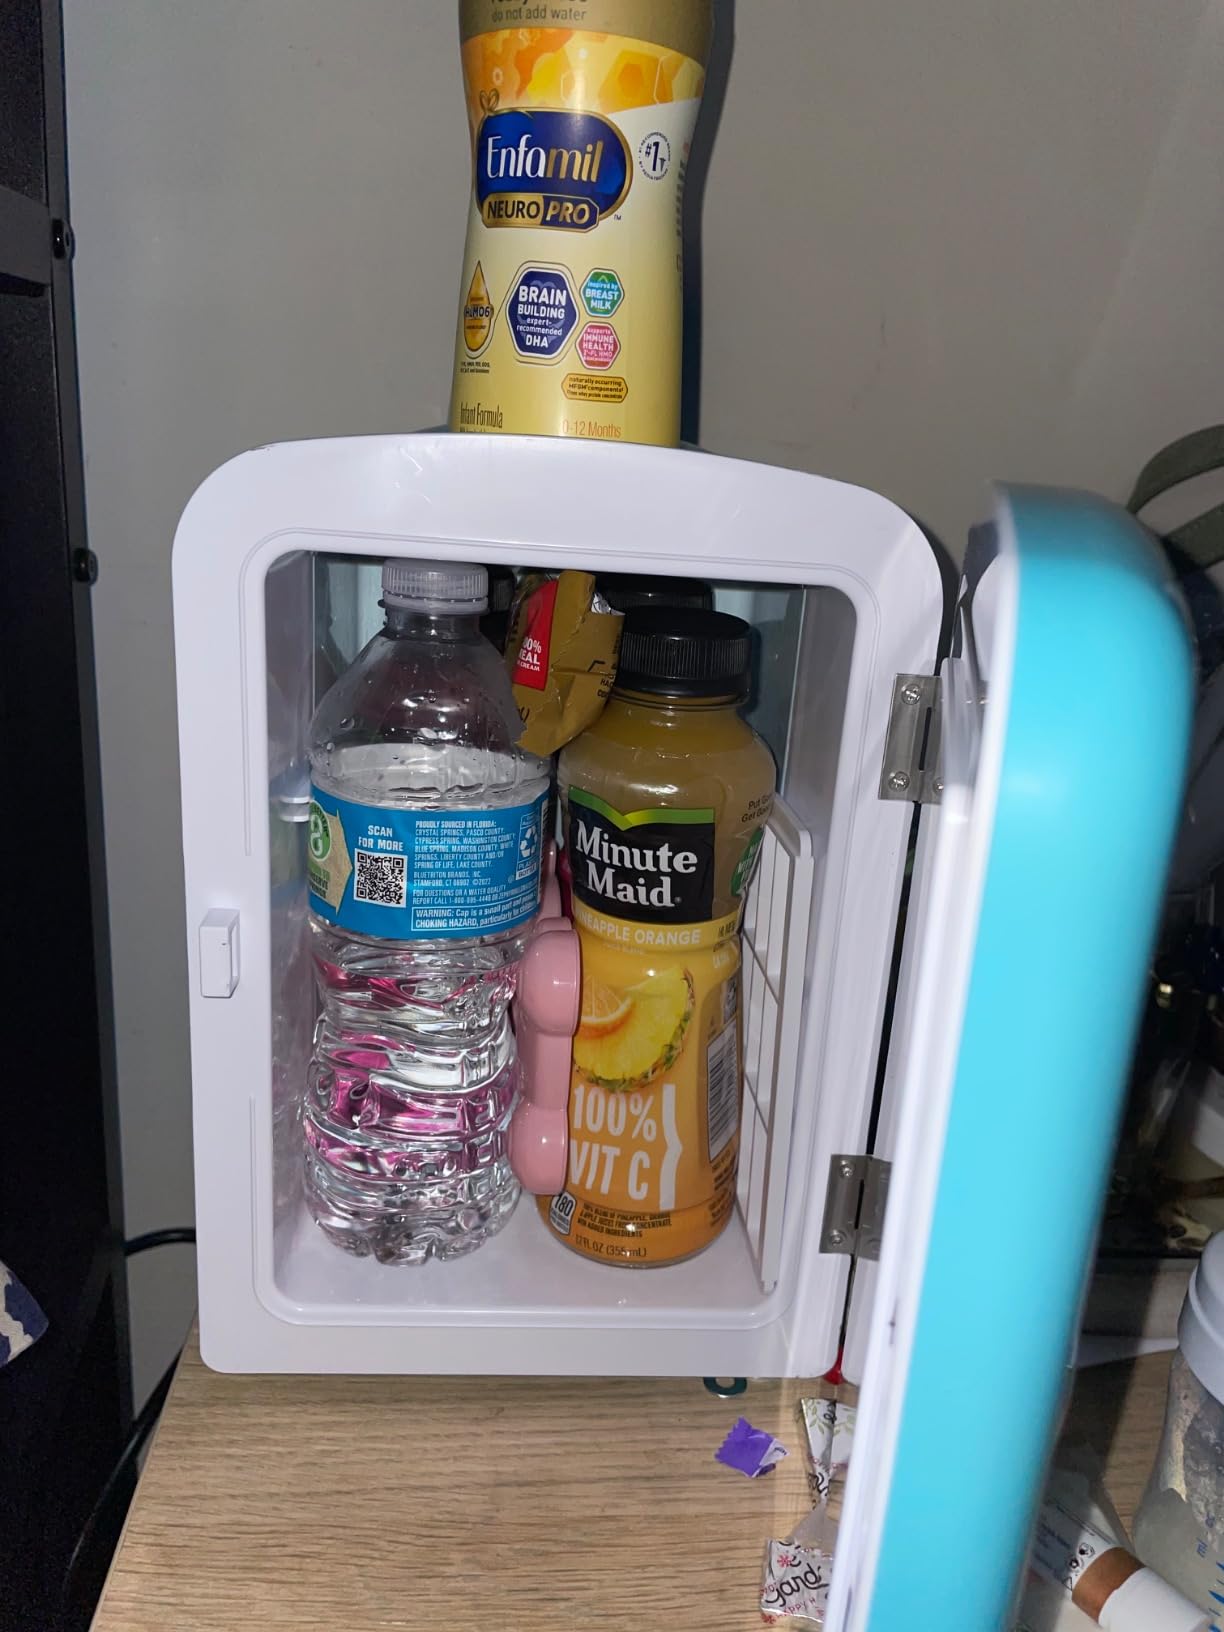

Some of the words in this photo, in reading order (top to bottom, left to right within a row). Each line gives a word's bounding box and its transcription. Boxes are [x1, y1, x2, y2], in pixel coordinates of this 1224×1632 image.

[505, 7, 522, 20] not
[525, 4, 547, 19] add
[552, 8, 587, 20] water
[487, 134, 604, 183] Enfamil
[487, 200, 541, 219] NEURO
[545, 201, 591, 224] PRO
[519, 286, 567, 306] BRAIN
[586, 289, 618, 300] BREAST
[518, 304, 565, 319] BUILDING
[591, 300, 611, 310] MILK
[526, 318, 552, 327] expert-
[517, 325, 562, 336] recommended
[525, 335, 549, 348] DHA
[583, 342, 613, 351] HEALTH
[584, 335, 614, 344] IMMUNE
[595, 379, 622, 387] occurring
[460, 401, 475, 425] Infant
[476, 402, 503, 429] Formula
[588, 421, 621, 438] Months
[519, 649, 540, 665] EAL
[367, 825, 393, 837] SCAN
[415, 820, 439, 828] PROUDLY
[466, 820, 472, 828] IN
[358, 837, 373, 848] FOR
[377, 839, 403, 851] MORE
[463, 836, 497, 844] WASHINGTON
[576, 819, 698, 874] Minute
[469, 887, 486, 895] WATER
[416, 909, 454, 917] WARNING:
[456, 909, 469, 918] Cap
[471, 908, 477, 916] is
[484, 904, 501, 915] small
[415, 918, 448, 928] CHOKING
[449, 918, 479, 928] HAZARD,
[634, 929, 701, 945] ORANGE
[573, 1084, 657, 1142] 100%
[570, 1139, 621, 1194] VIT
[627, 1150, 650, 1201] C
[555, 1192, 574, 1217] 180
[592, 1239, 604, 1253] OZ
